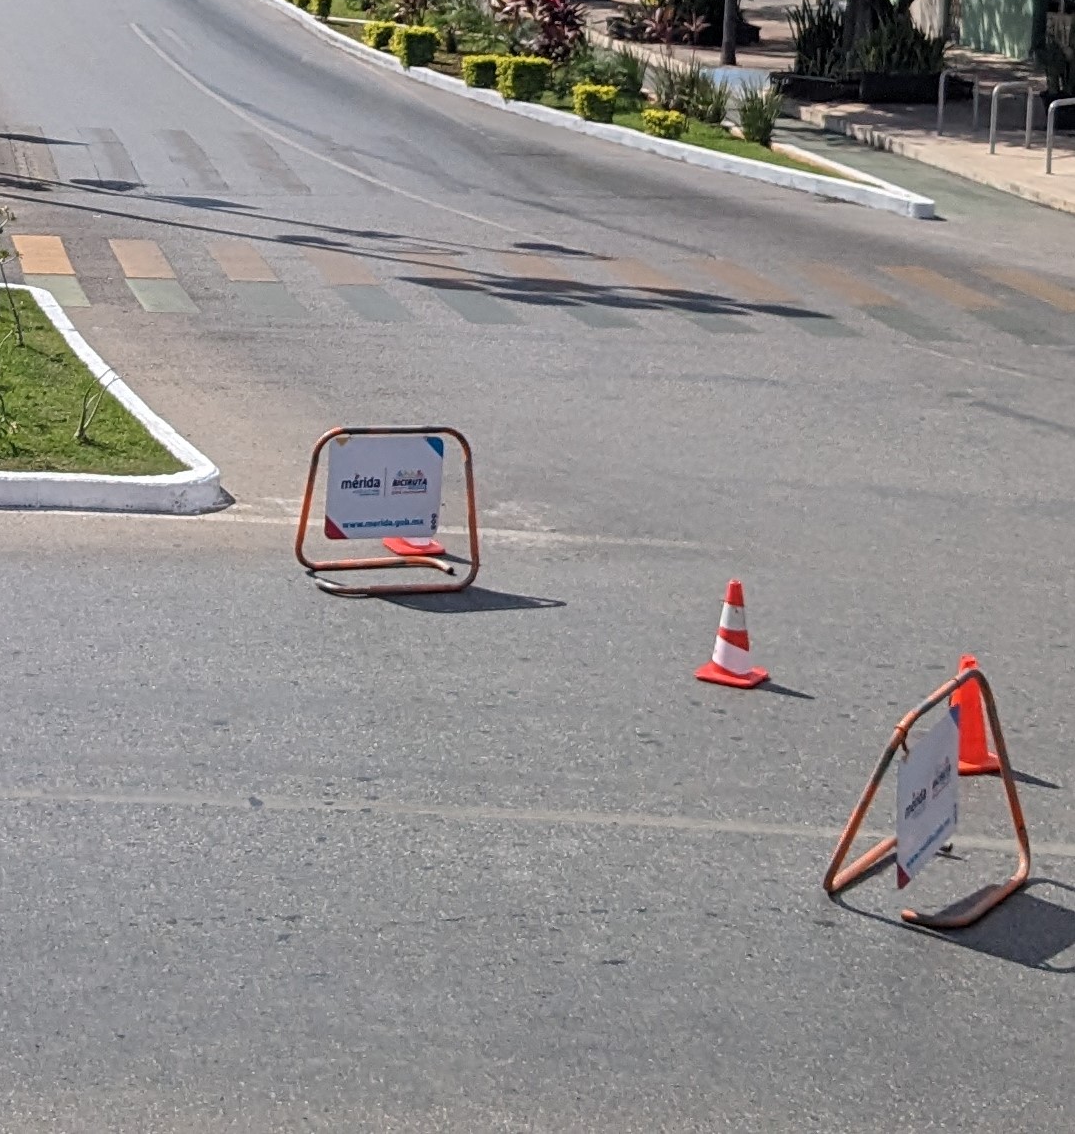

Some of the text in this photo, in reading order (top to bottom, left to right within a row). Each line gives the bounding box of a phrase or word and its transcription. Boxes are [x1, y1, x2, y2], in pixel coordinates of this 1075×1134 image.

[340, 473, 381, 489] mérida
[392, 478, 428, 487] BICIRUTA
[342, 518, 424, 529] www.merida.gob.mx
